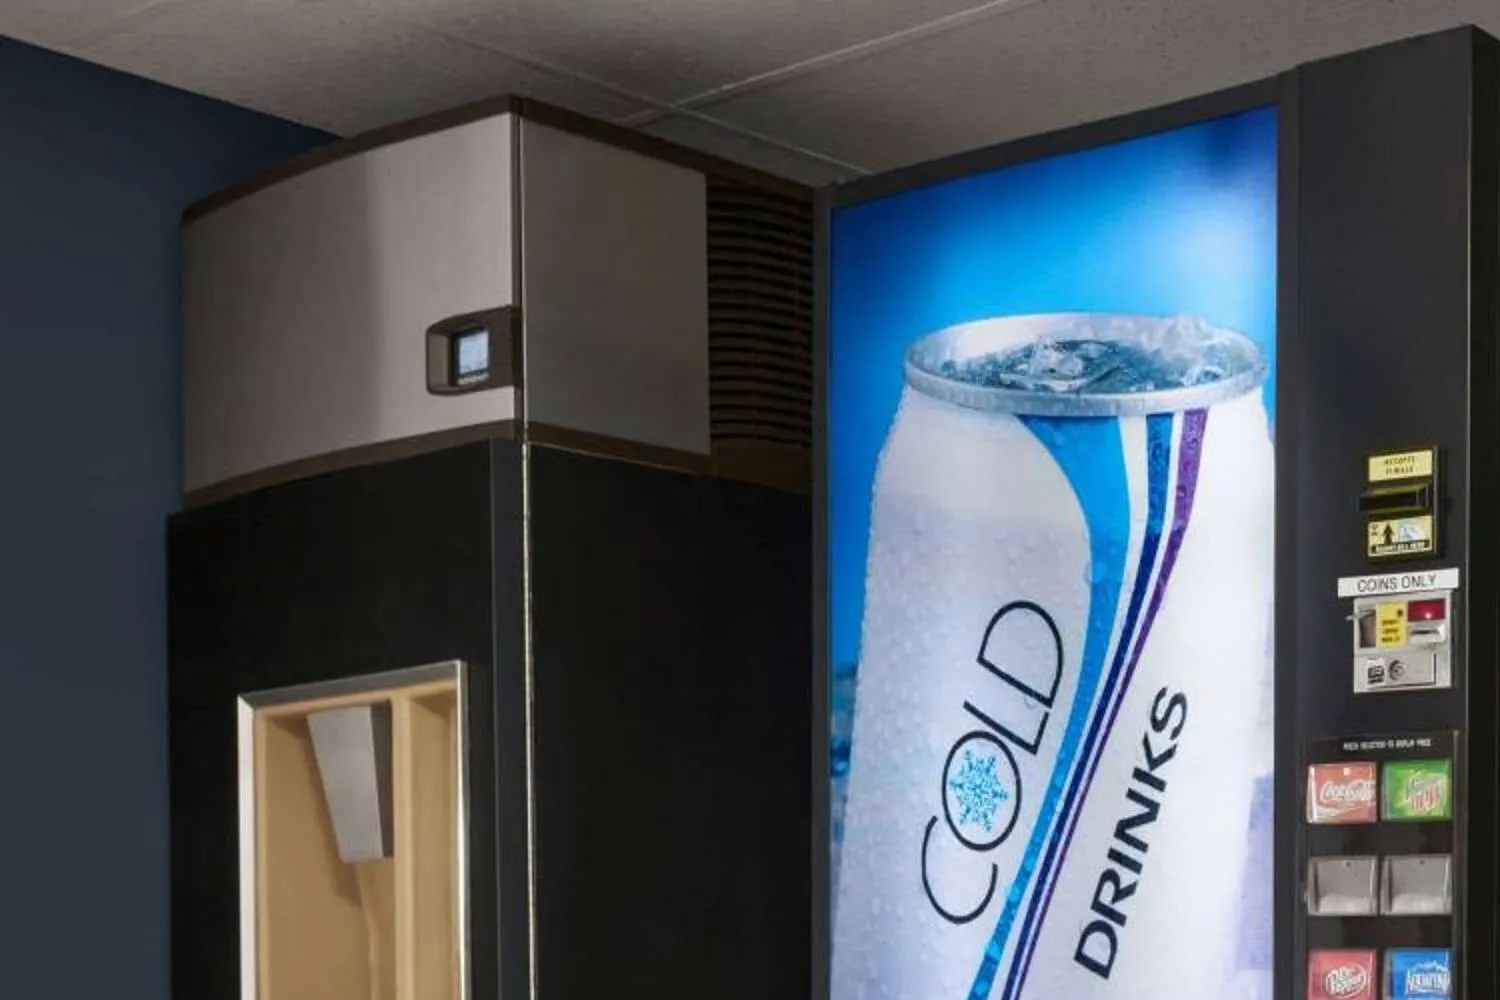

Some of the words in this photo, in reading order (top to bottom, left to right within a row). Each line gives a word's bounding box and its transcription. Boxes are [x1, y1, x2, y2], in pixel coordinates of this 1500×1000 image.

[1357, 576, 1397, 593] COINS
[1401, 573, 1437, 590] ONLY
[922, 601, 1064, 924] COLD
[1073, 687, 1188, 980] DRINKS
